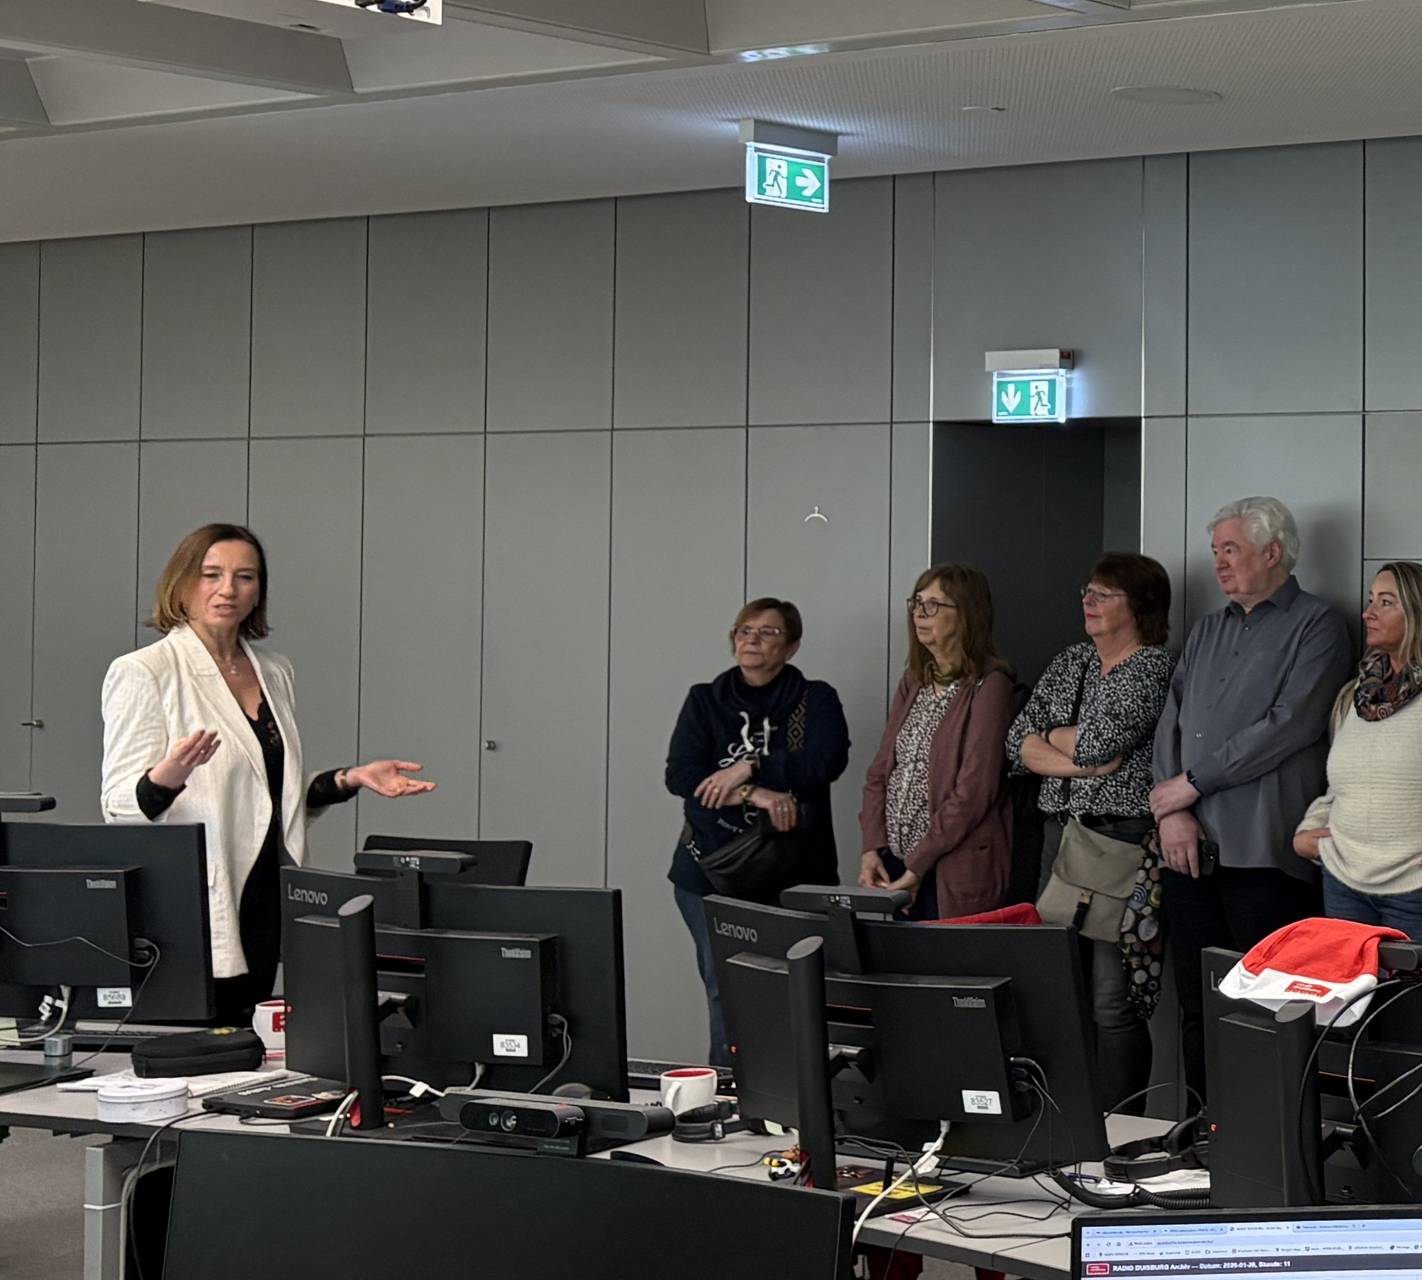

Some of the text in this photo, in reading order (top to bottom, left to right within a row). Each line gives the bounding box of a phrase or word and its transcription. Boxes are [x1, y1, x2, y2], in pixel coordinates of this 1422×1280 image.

[288, 883, 328, 906] Lenovo
[713, 917, 758, 943] Lenovo
[1113, 1264, 1134, 1272] RADIO
[1135, 1264, 1169, 1272] DUISBURG
